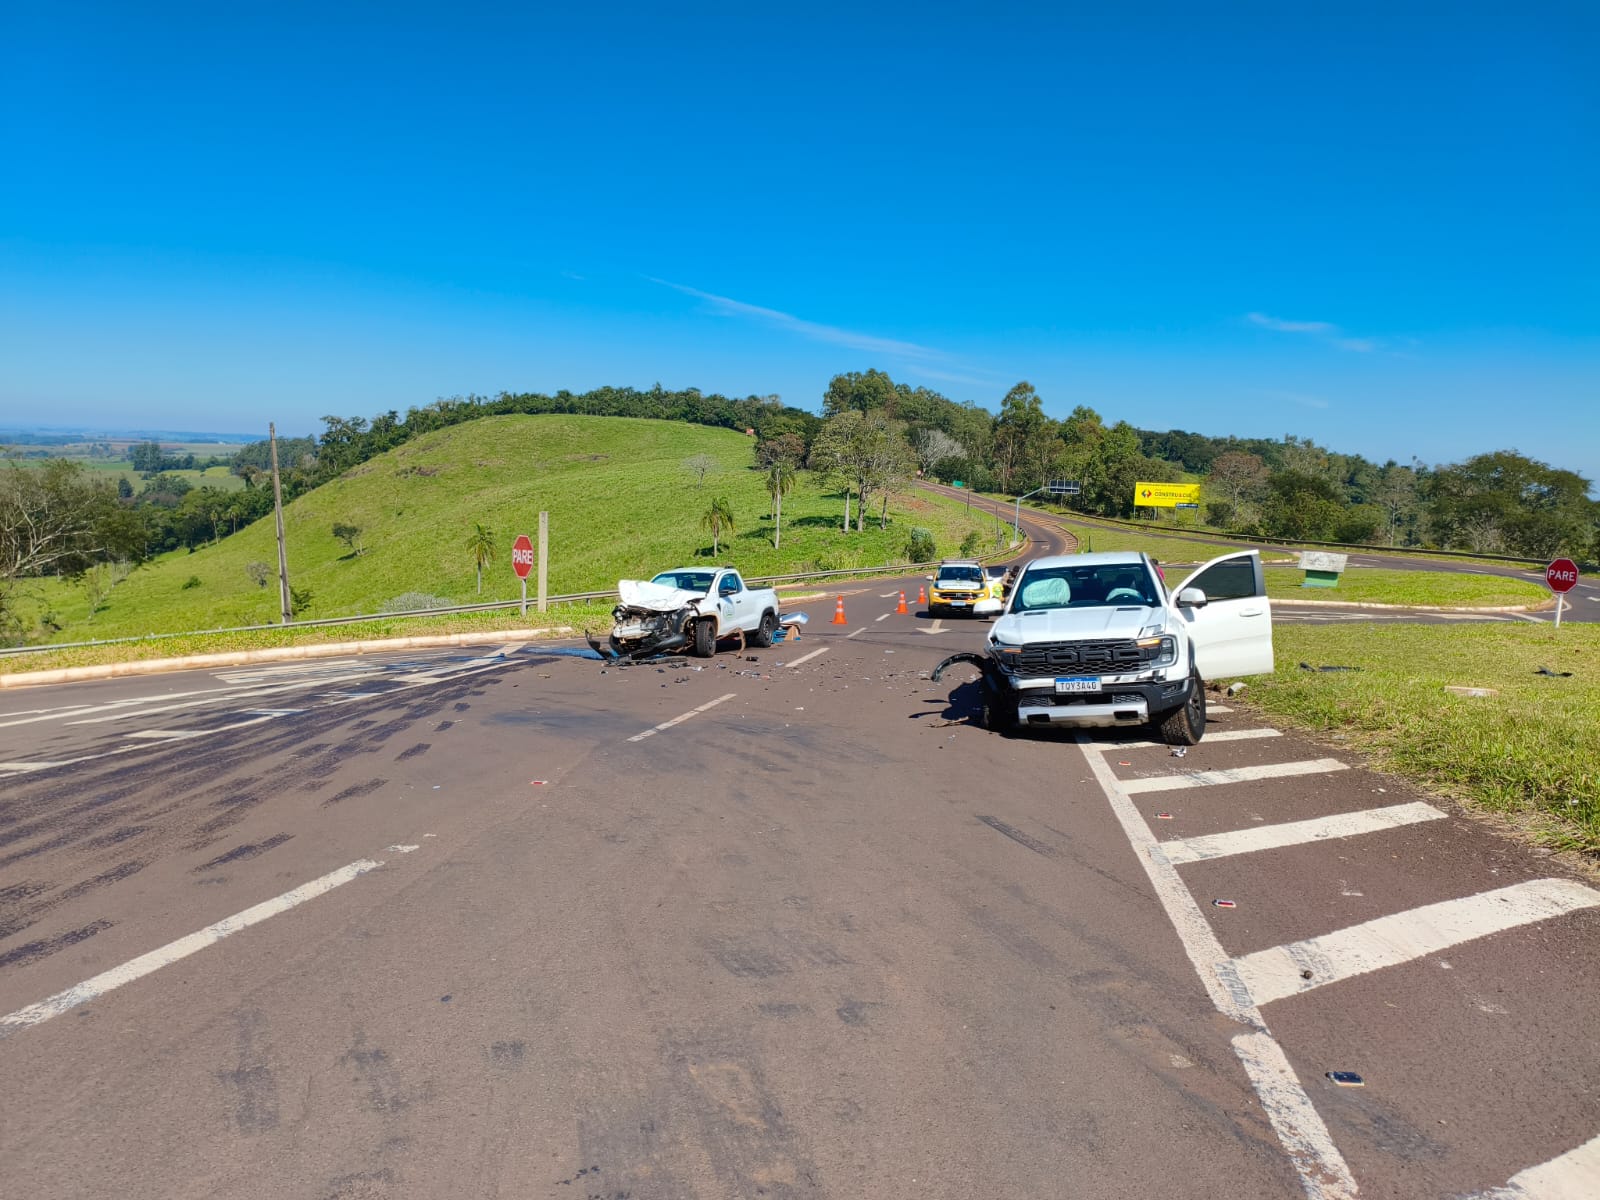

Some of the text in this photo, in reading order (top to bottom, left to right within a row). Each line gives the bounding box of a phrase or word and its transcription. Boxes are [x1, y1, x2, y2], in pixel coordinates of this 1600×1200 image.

[513, 549, 533, 565] PARE
[1548, 569, 1576, 582] PARE
[1020, 648, 1147, 665] FORD
